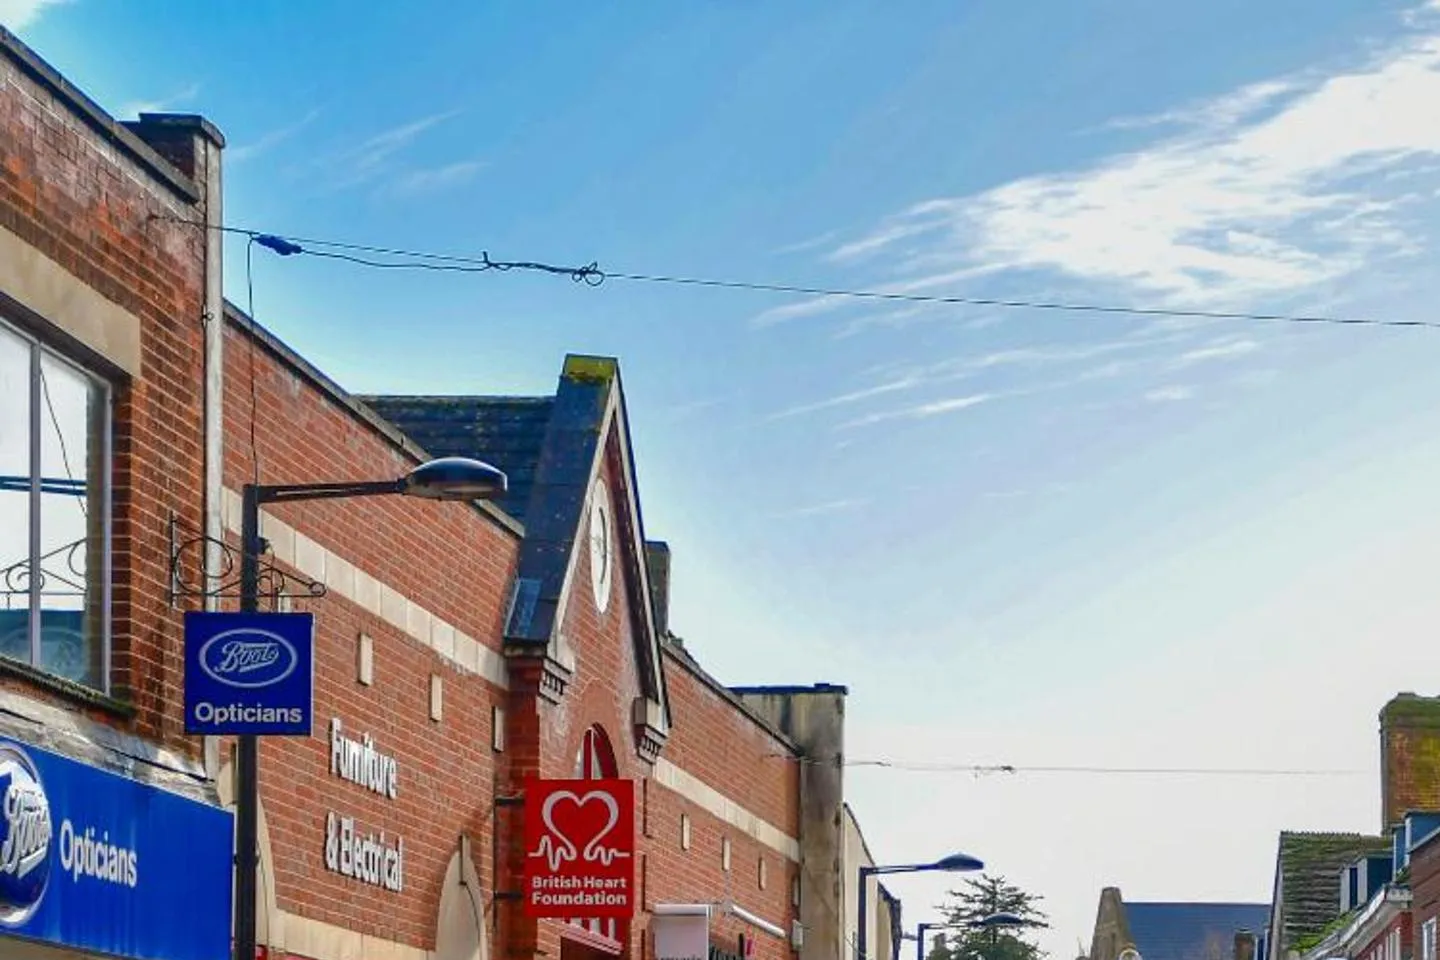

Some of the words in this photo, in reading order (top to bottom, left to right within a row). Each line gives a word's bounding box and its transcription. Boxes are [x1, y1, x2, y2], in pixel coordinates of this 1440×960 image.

[213, 641, 279, 673] Boots
[195, 702, 303, 724] Opticians
[331, 717, 397, 799] Furniture
[60, 819, 137, 887] Opticians
[326, 811, 339, 871] &
[341, 816, 402, 891] Electrical
[532, 876, 582, 889] British
[584, 876, 626, 889] Heart
[532, 891, 626, 905] Foundation
